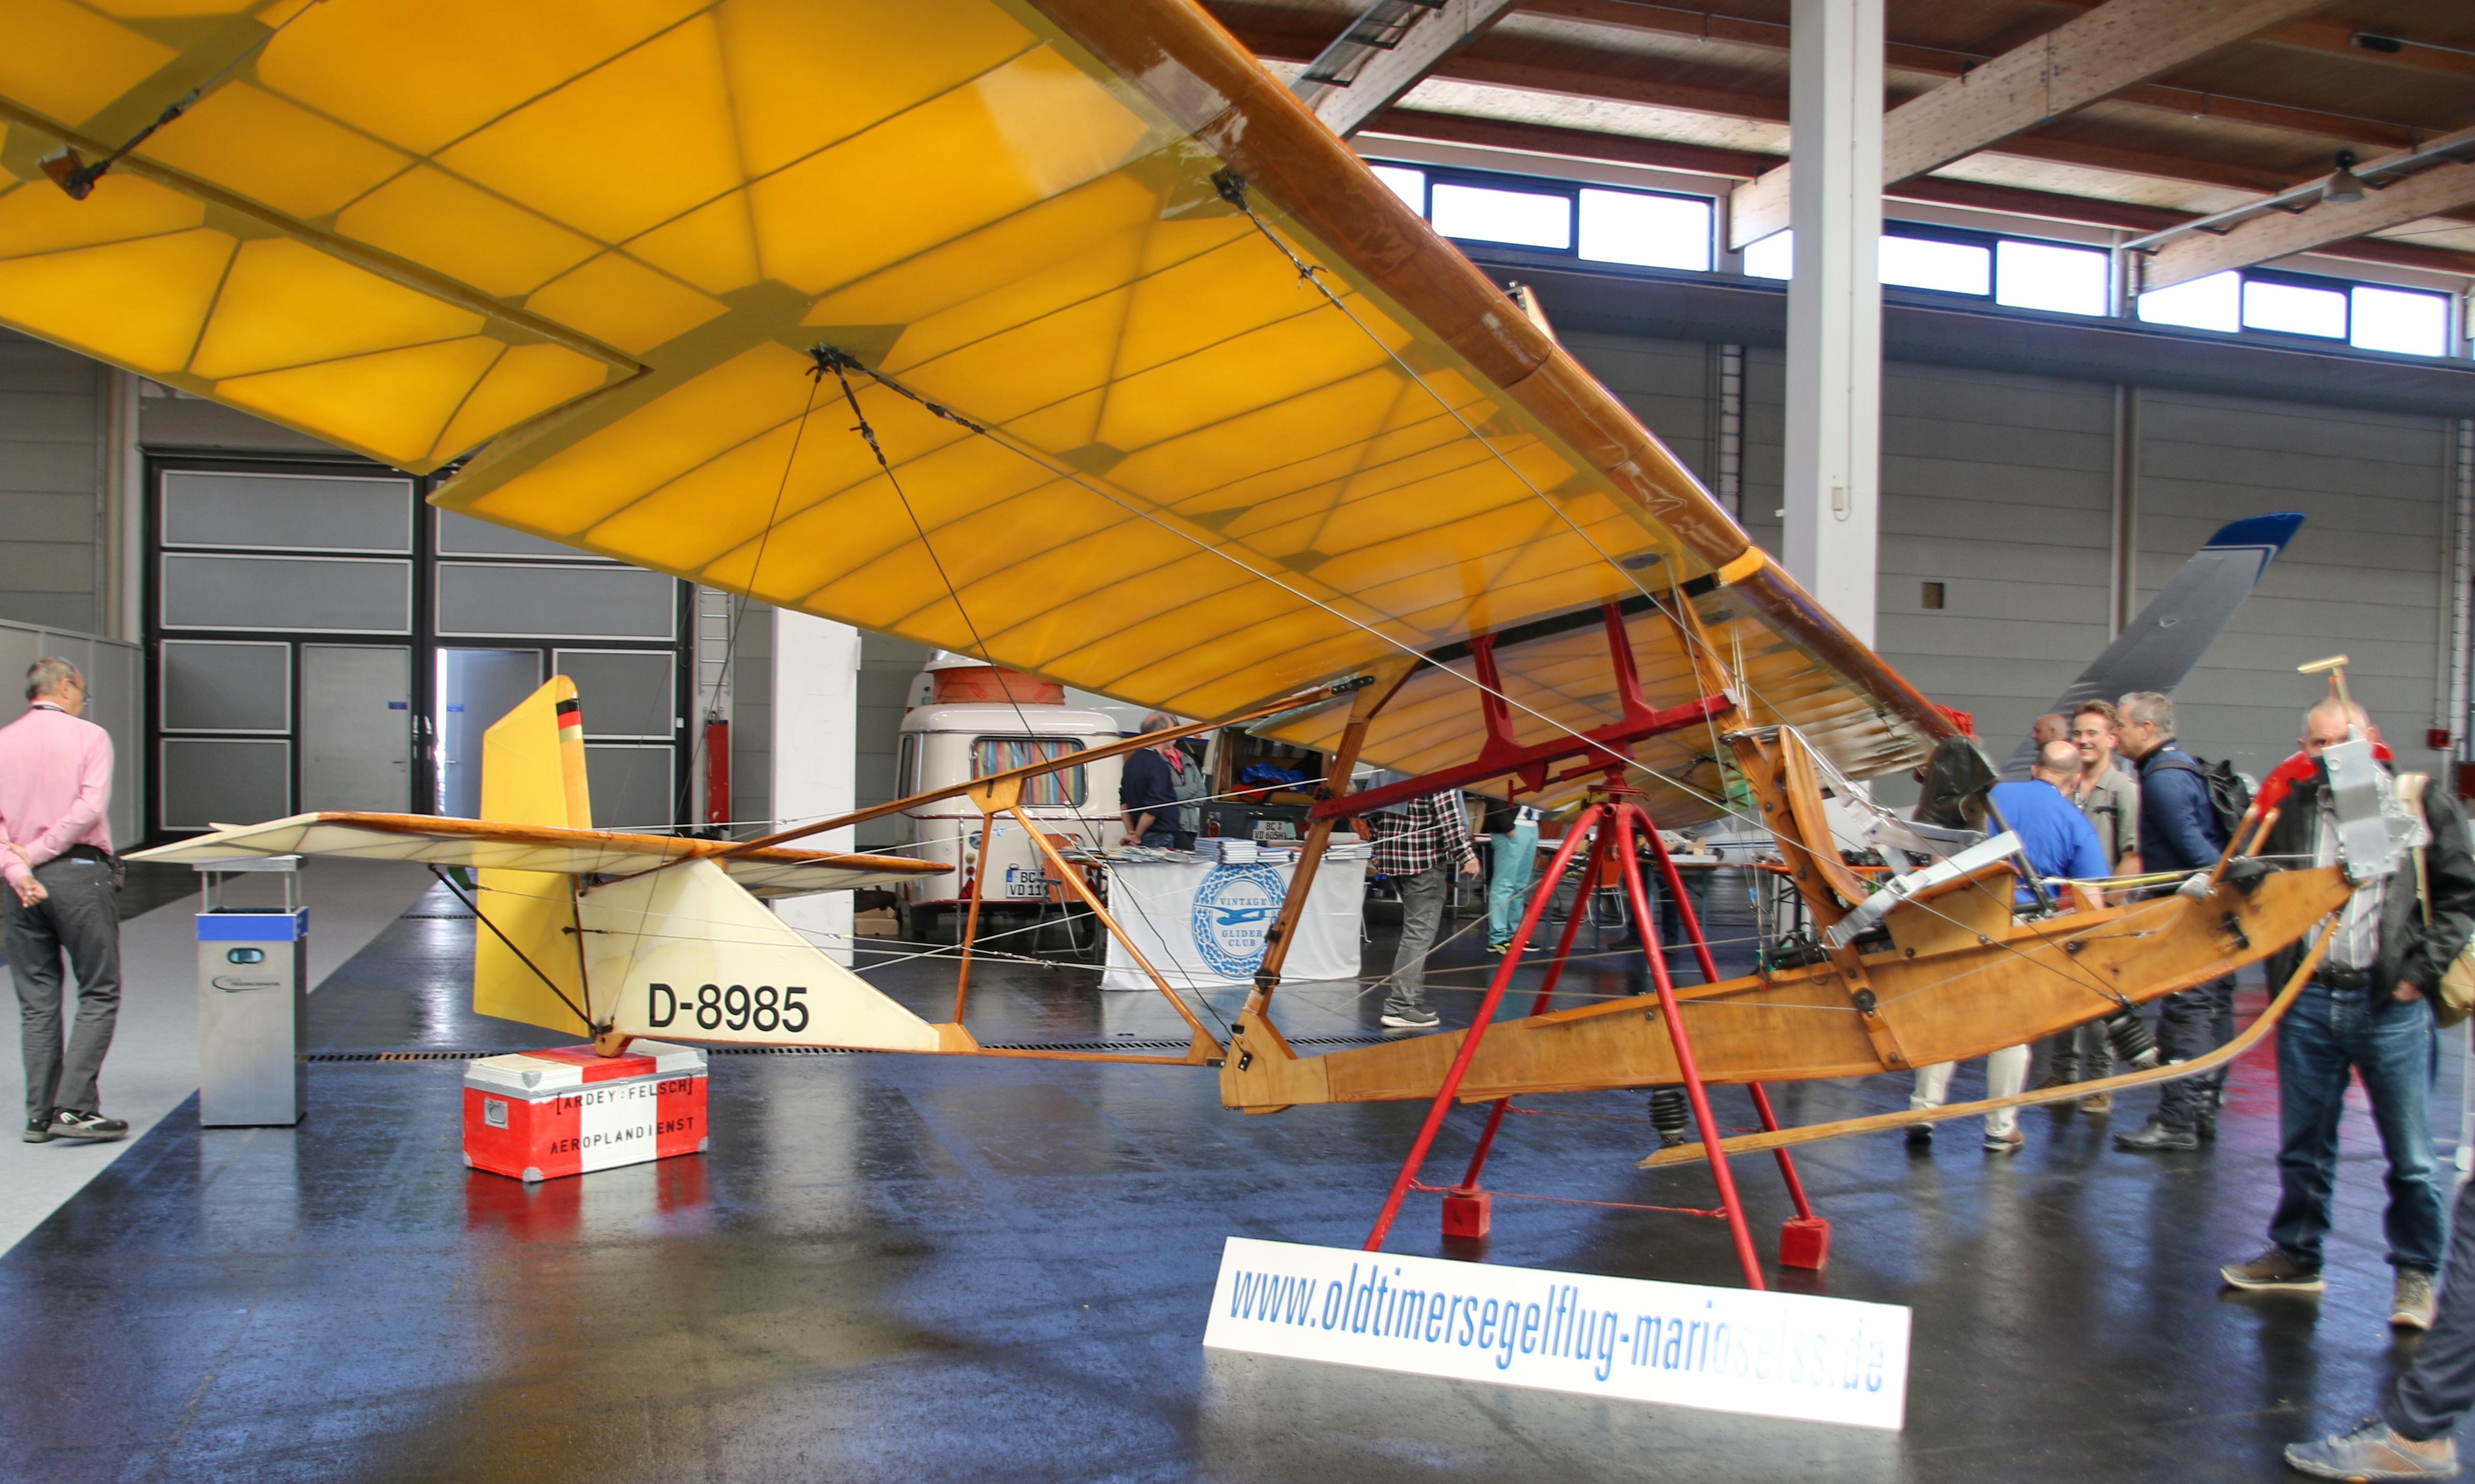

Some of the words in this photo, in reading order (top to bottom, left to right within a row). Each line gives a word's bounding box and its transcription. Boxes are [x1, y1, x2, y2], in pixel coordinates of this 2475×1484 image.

[1266, 822, 1276, 831] BC
[1021, 872, 1035, 883] BC
[1010, 884, 1025, 895] VD
[649, 983, 809, 1032] D-8985
[549, 1116, 694, 1155] AEROPLANDIENST
